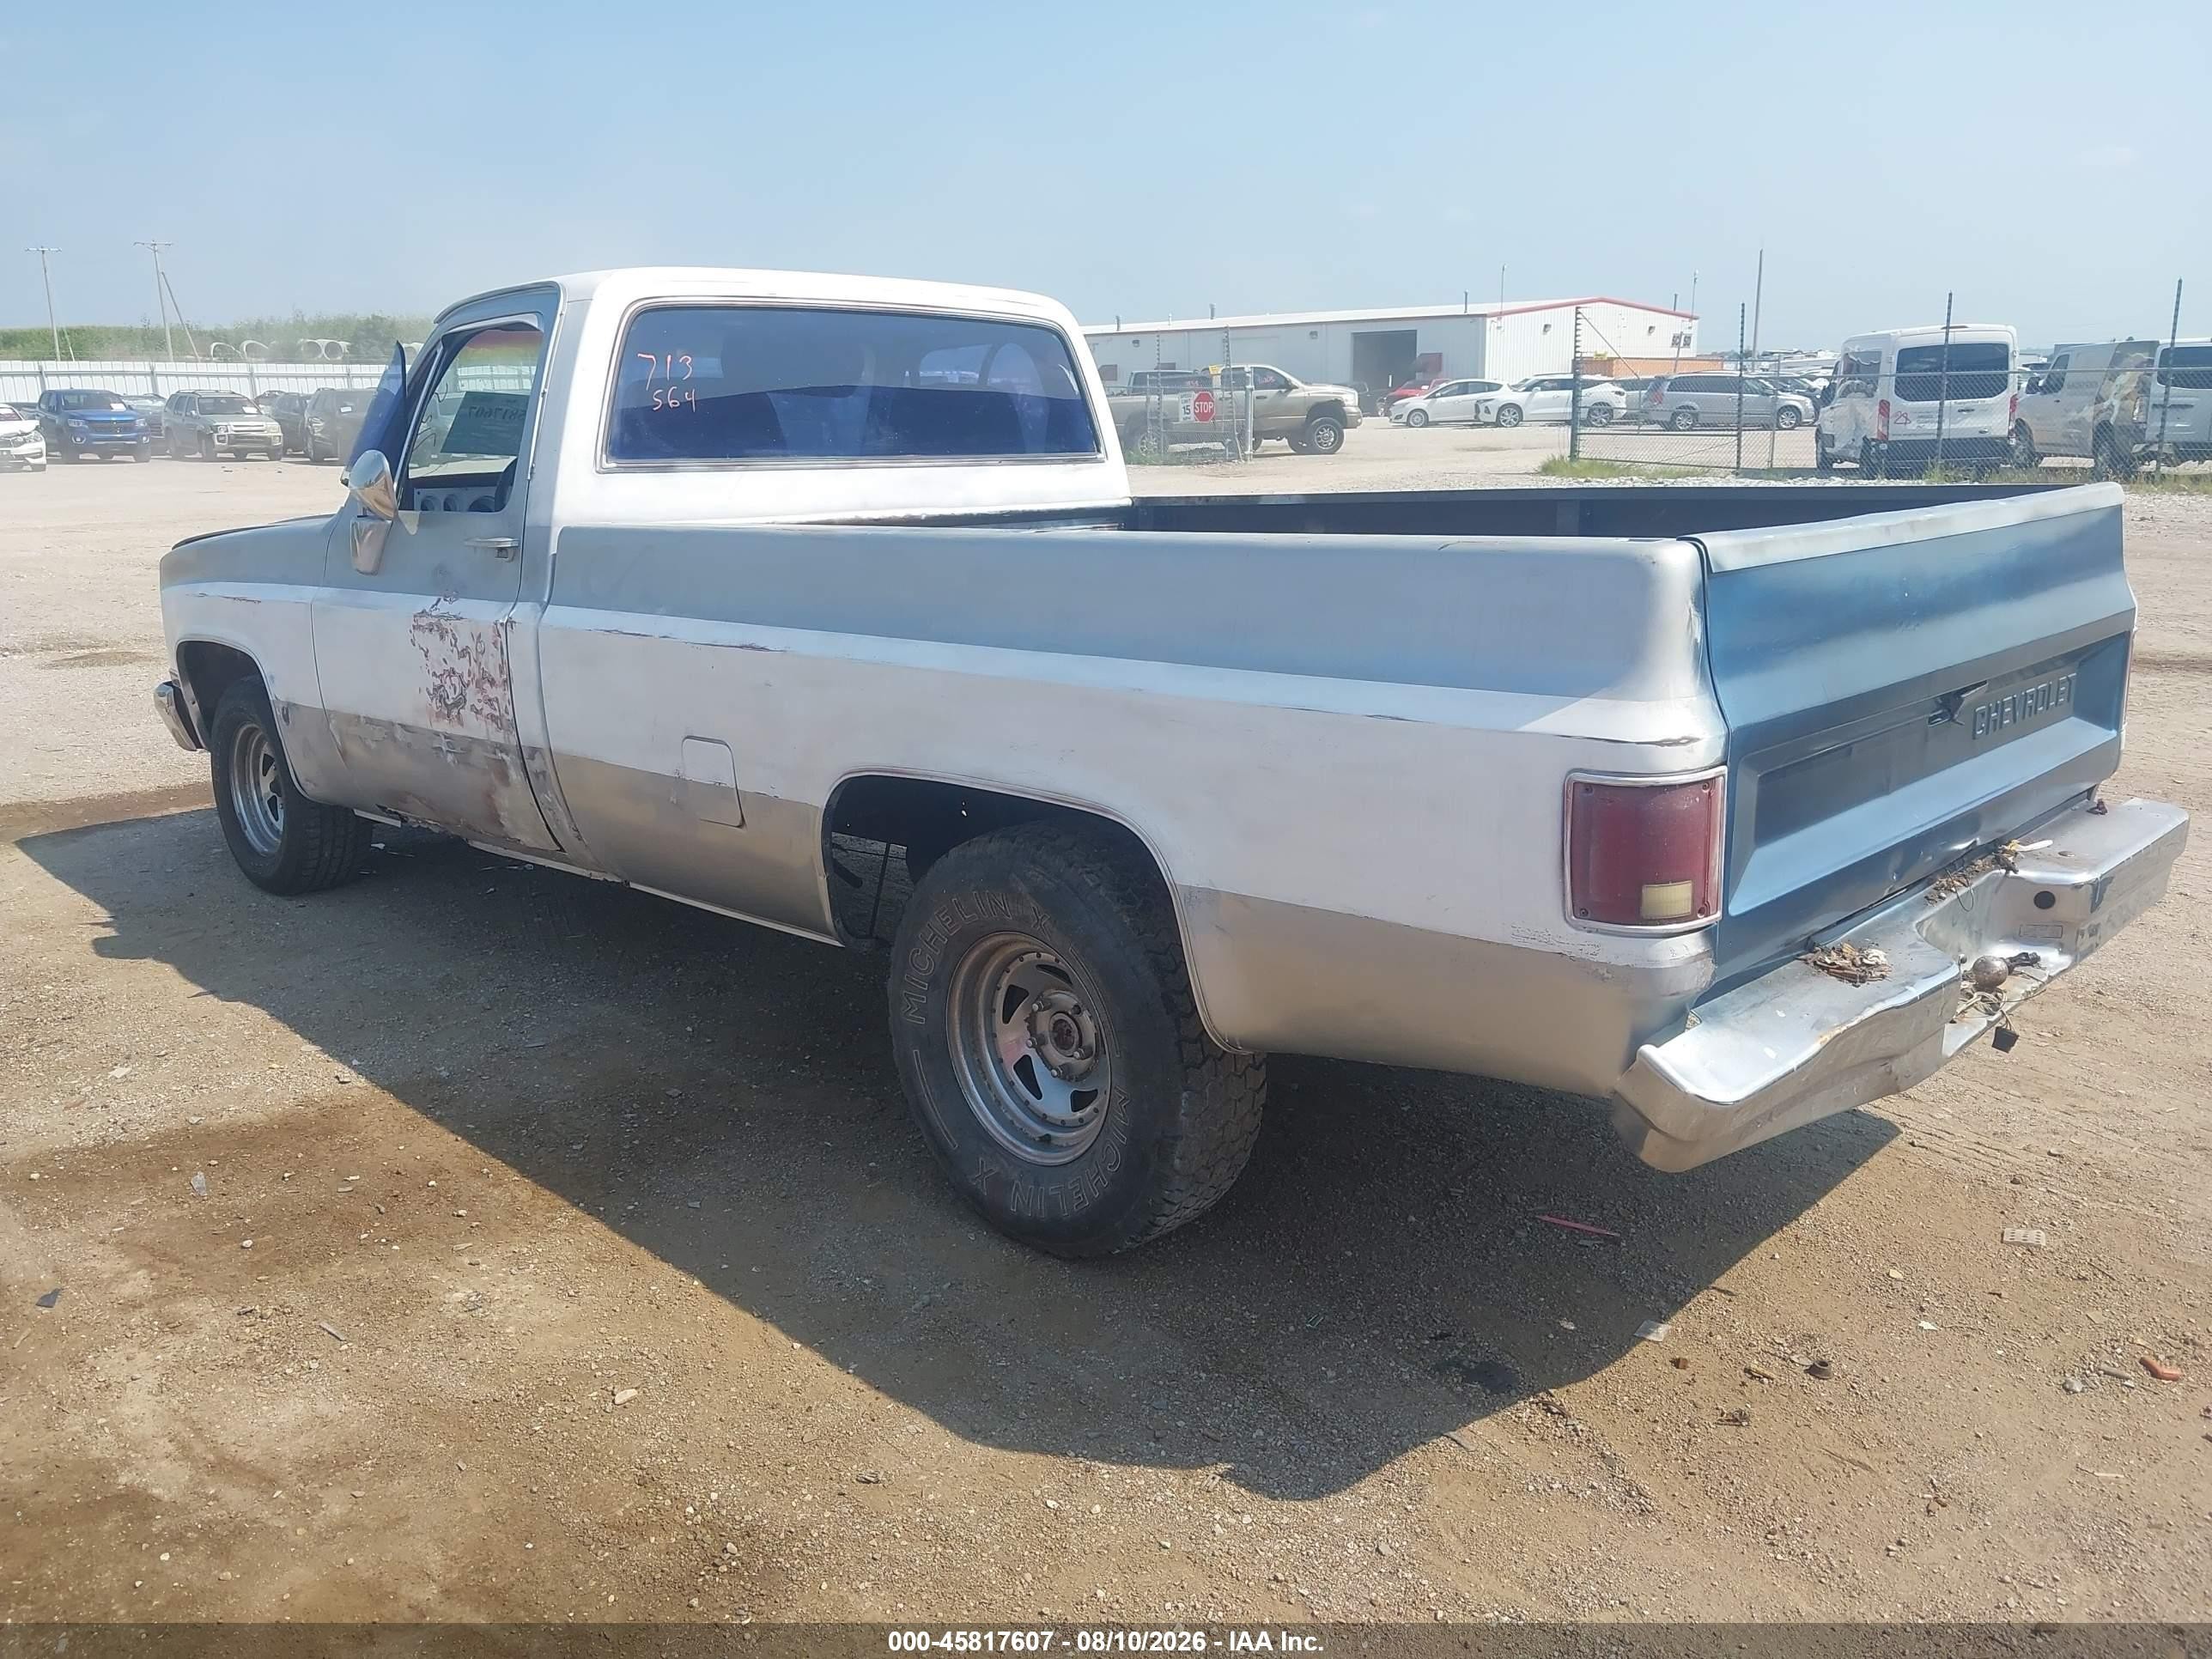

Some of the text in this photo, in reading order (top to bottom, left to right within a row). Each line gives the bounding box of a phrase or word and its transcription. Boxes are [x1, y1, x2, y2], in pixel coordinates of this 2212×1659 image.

[637, 353, 692, 391] 713
[652, 386, 696, 413] 564
[1182, 404, 1191, 415] 15
[1194, 402, 1214, 413] STOP
[1972, 672, 2077, 739] CHEVROLET
[902, 890, 1012, 1024] MICHELIN
[1010, 1085, 1131, 1218] MICHELIN
